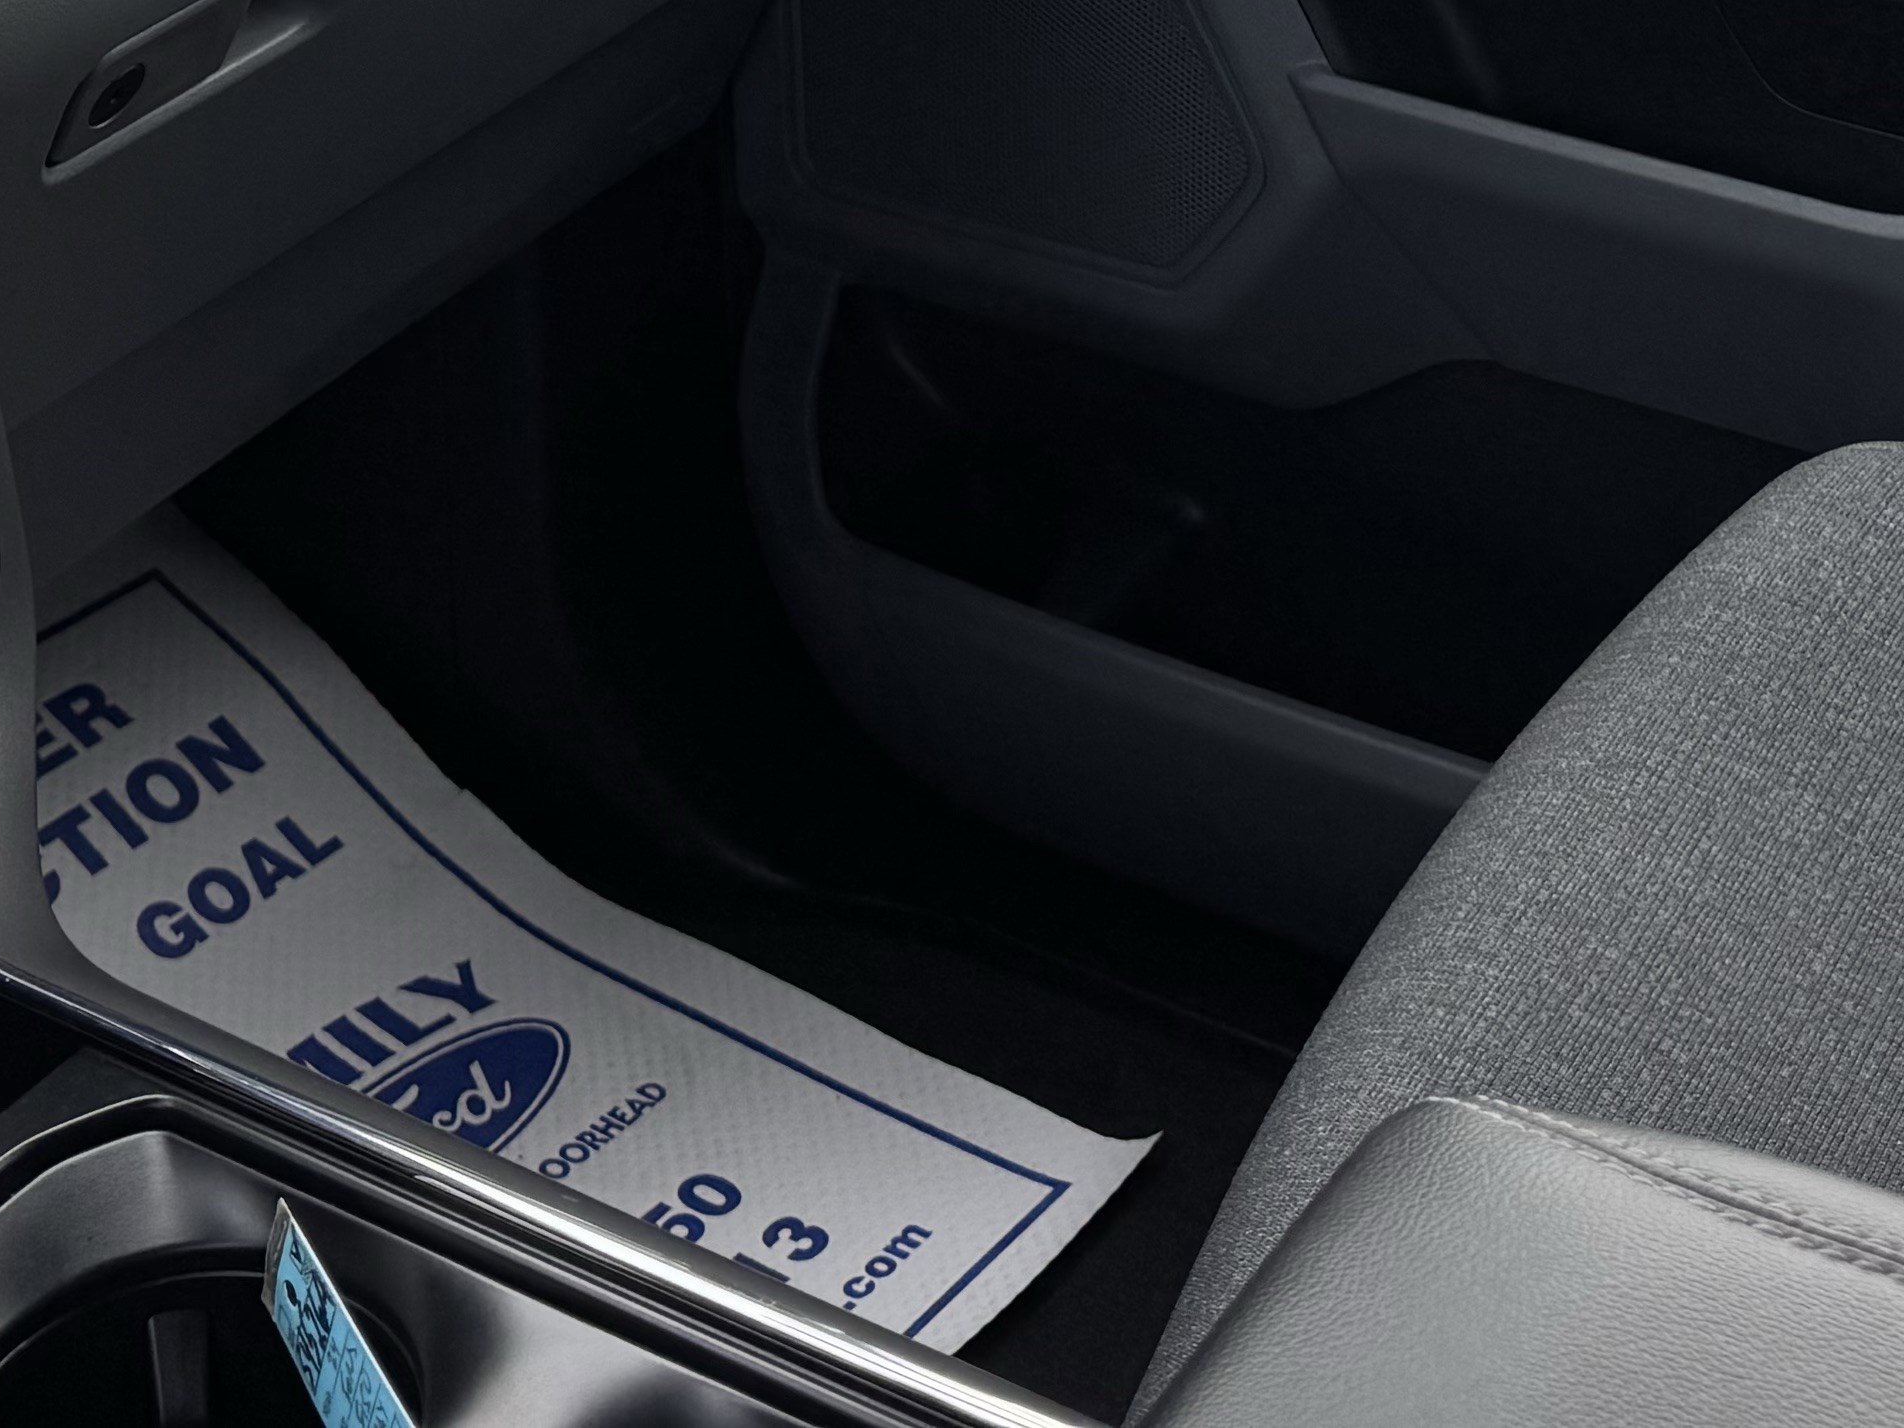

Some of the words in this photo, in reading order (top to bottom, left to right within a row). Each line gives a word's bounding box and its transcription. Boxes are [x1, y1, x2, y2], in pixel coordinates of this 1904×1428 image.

[37, 714, 266, 906] TION
[136, 815, 346, 959] GOAL
[539, 1082, 668, 1179] OORHEAD
[842, 1223, 933, 1312] .com
